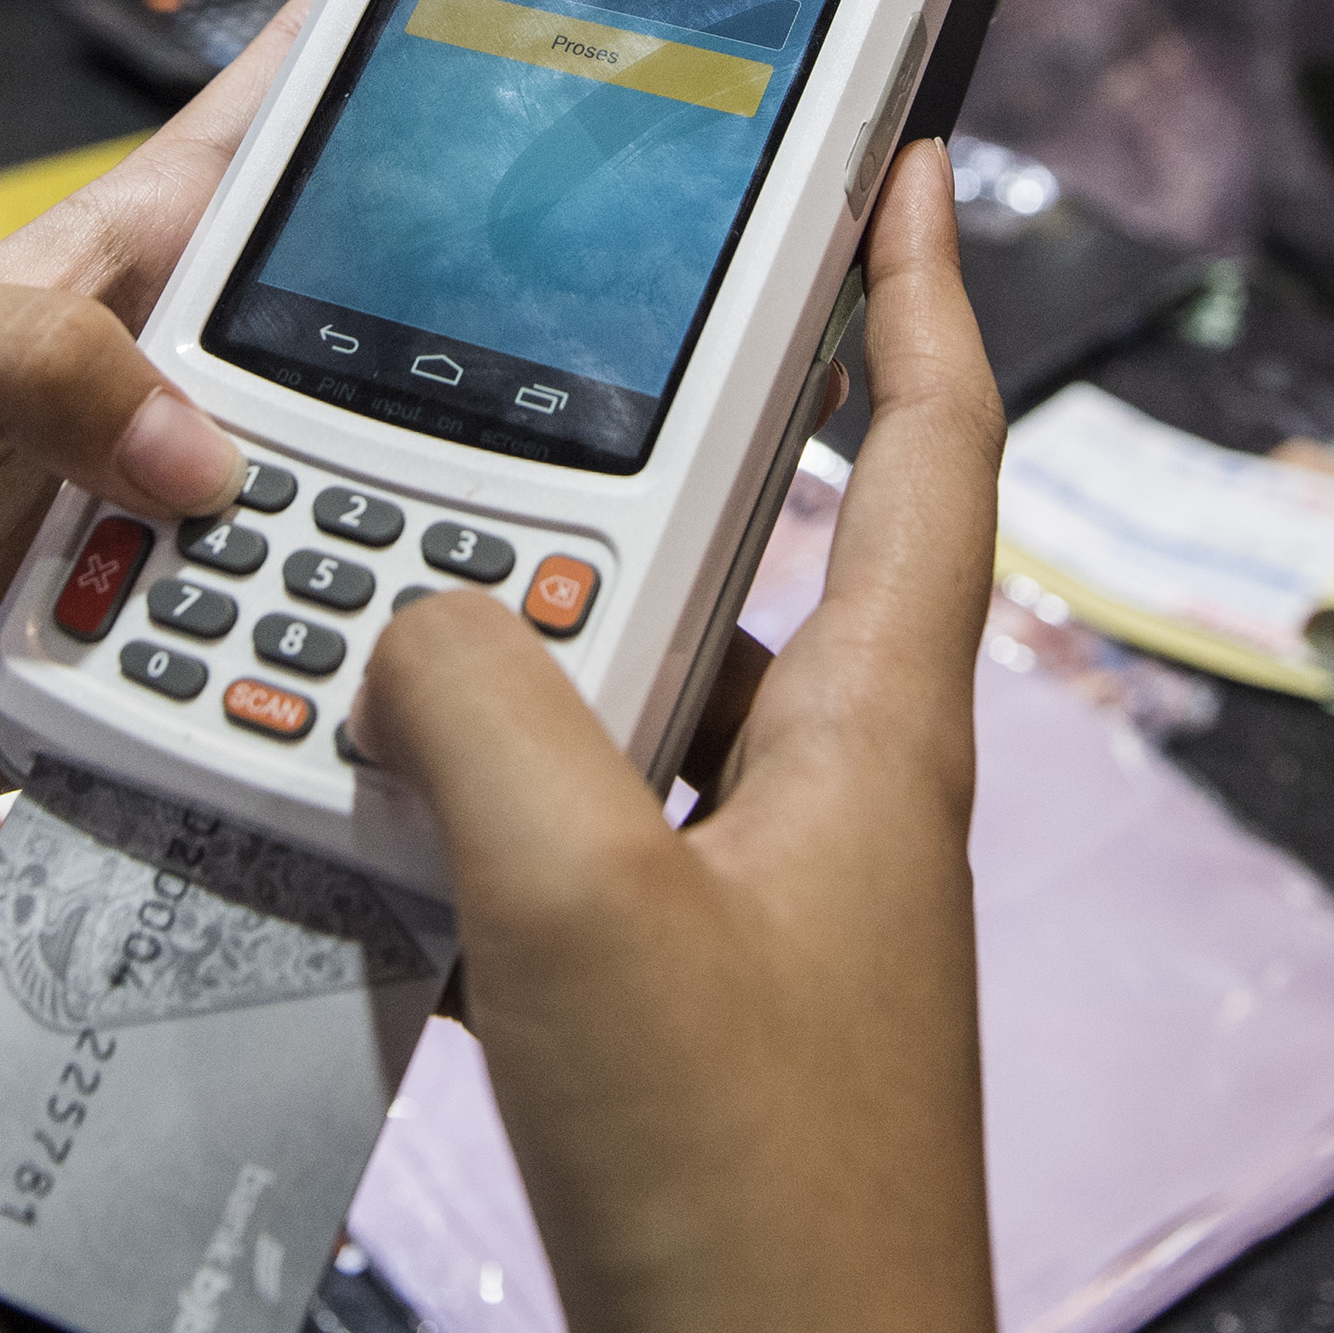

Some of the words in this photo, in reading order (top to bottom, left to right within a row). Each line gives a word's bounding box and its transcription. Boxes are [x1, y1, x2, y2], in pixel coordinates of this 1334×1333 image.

[551, 34, 619, 64] Proses
[318, 375, 357, 403] PIN
[371, 396, 422, 422] input
[436, 415, 464, 435] on
[479, 429, 551, 461] screen
[242, 465, 260, 494] 1
[339, 495, 368, 528] 2
[204, 524, 230, 555] 4
[449, 529, 478, 562] 3
[309, 559, 339, 590] 5
[172, 585, 202, 617] 7
[278, 621, 308, 656] 8
[147, 650, 170, 679] 0
[230, 681, 304, 728] SCAN
[205, 1164, 276, 1264] bank
